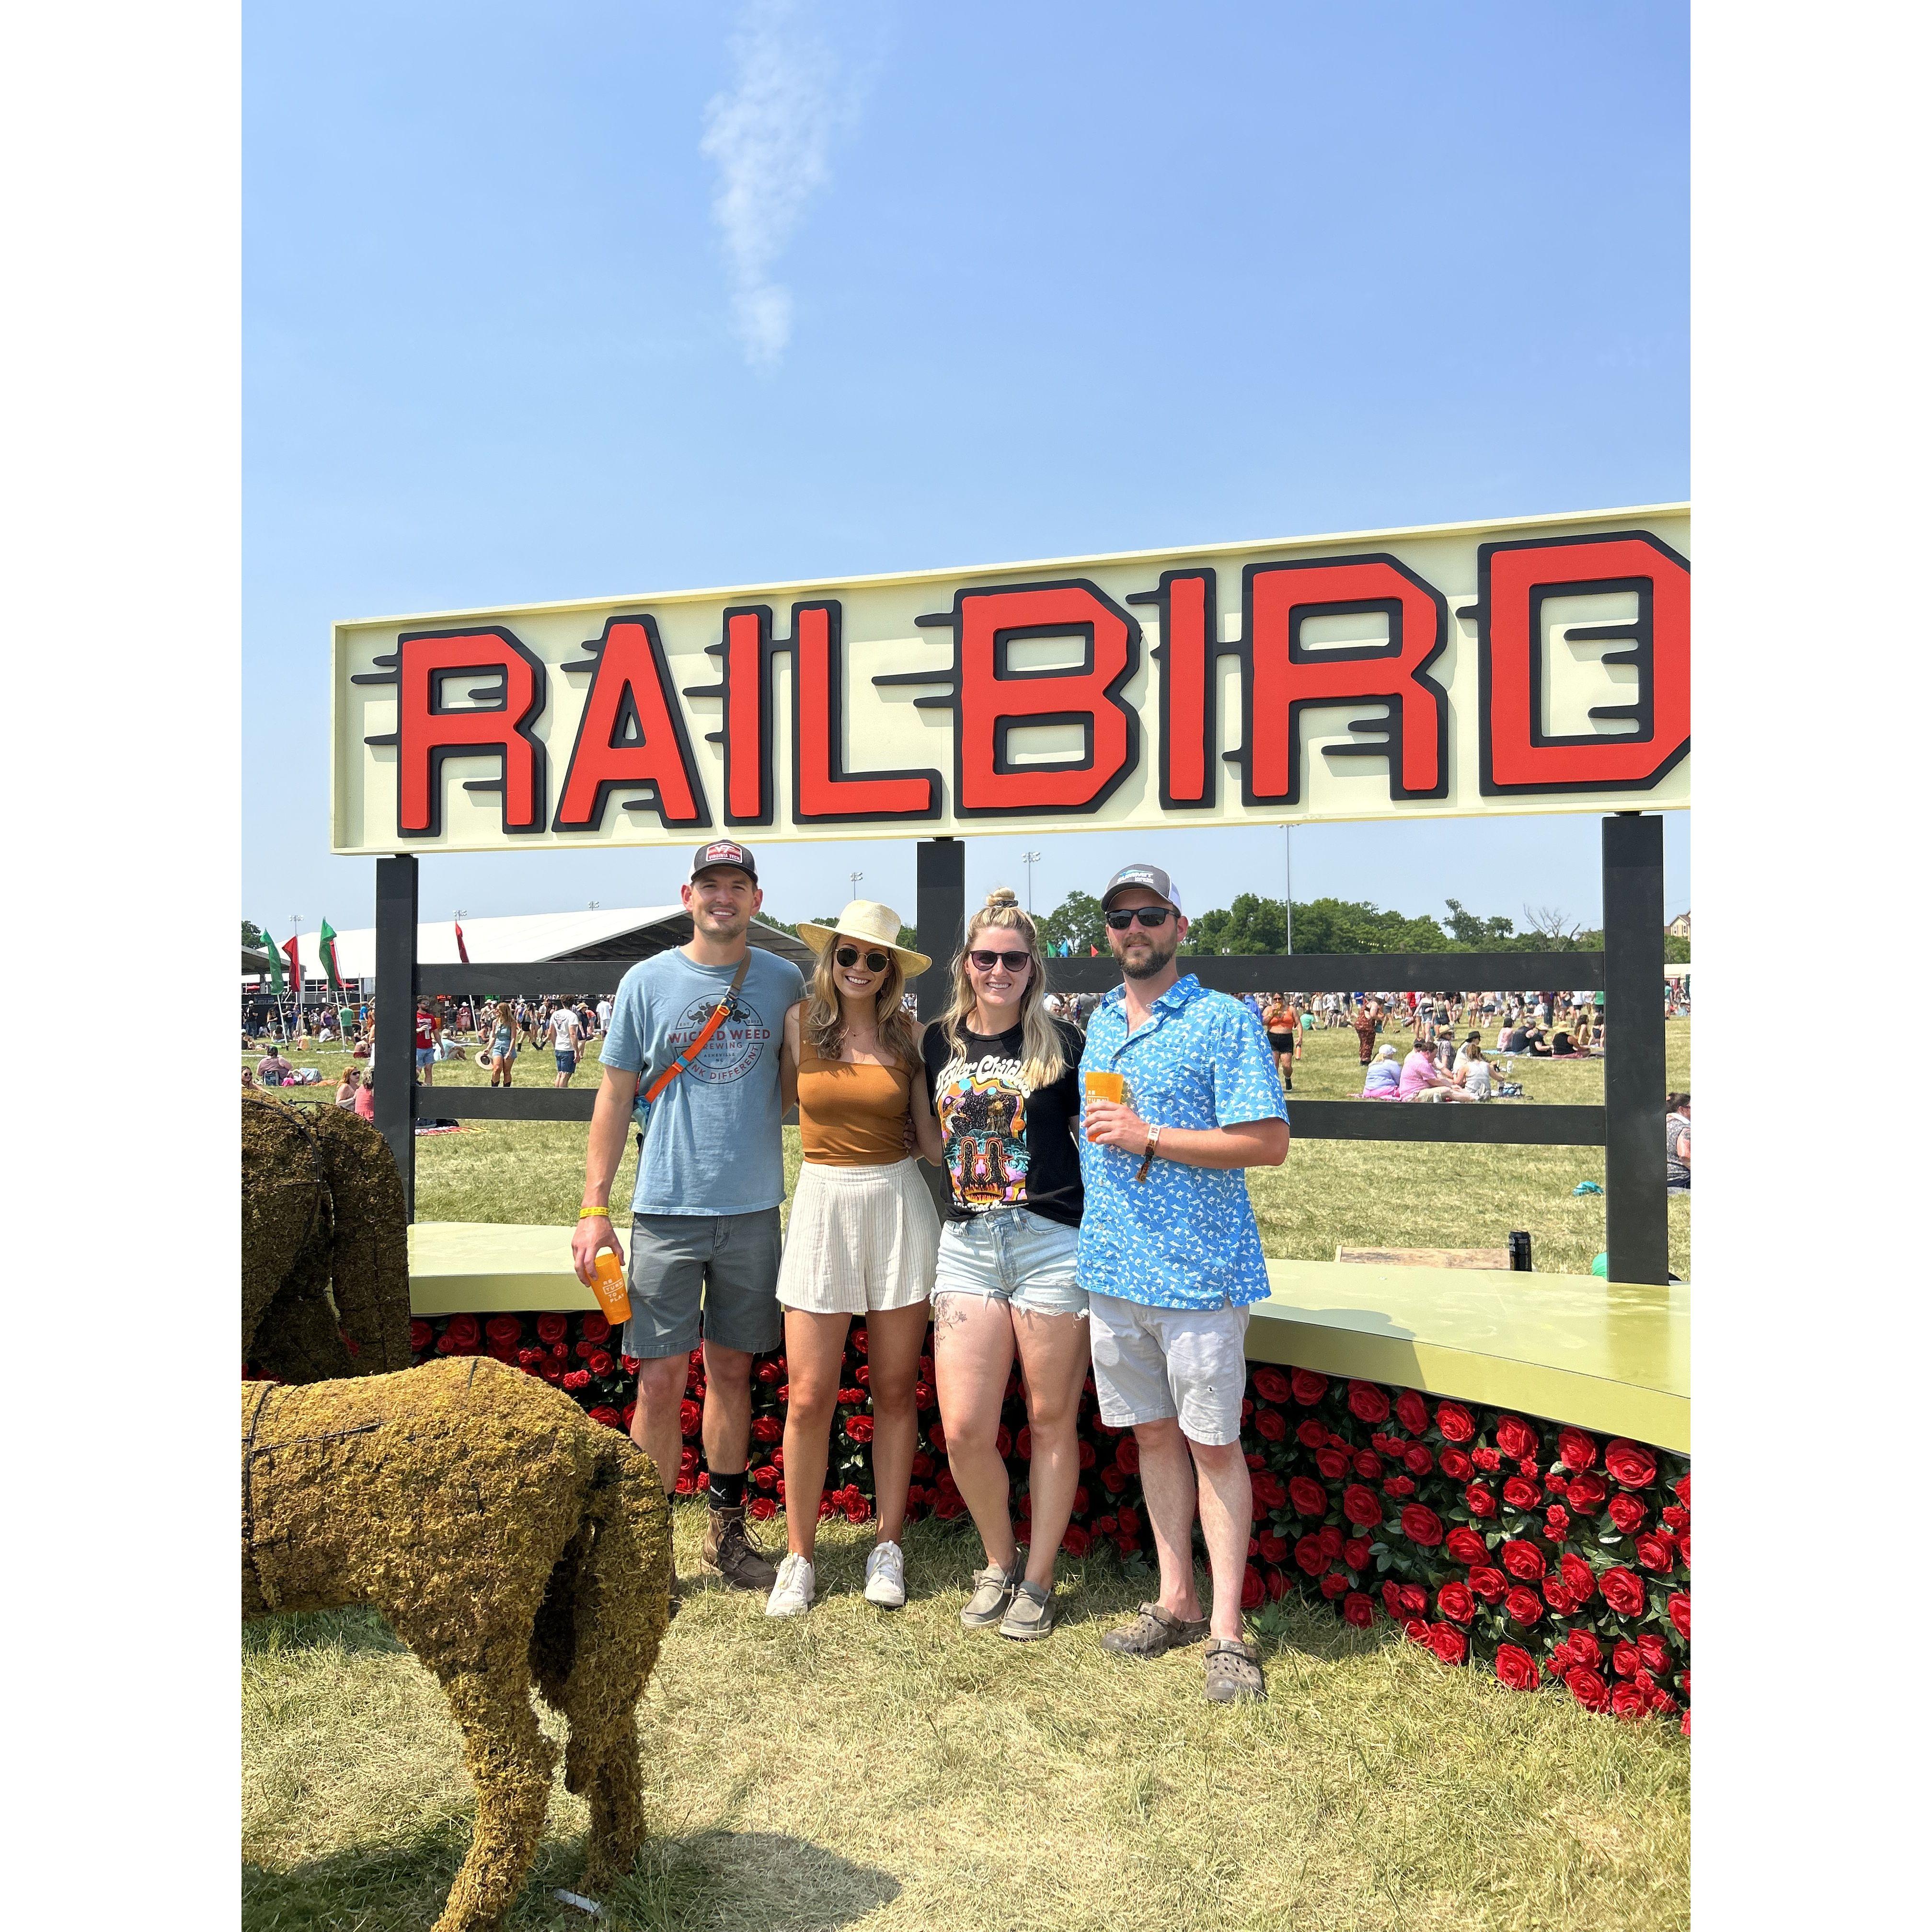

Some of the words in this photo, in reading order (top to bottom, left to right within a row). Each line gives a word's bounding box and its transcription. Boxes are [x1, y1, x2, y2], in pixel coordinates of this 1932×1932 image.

[397, 530, 1690, 837] RAILBIRD
[730, 1029, 770, 1040] WEED
[710, 1046, 759, 1080] DIFFERENT
[605, 1281, 622, 1292] TURN
[610, 1293, 624, 1303] PLAY
